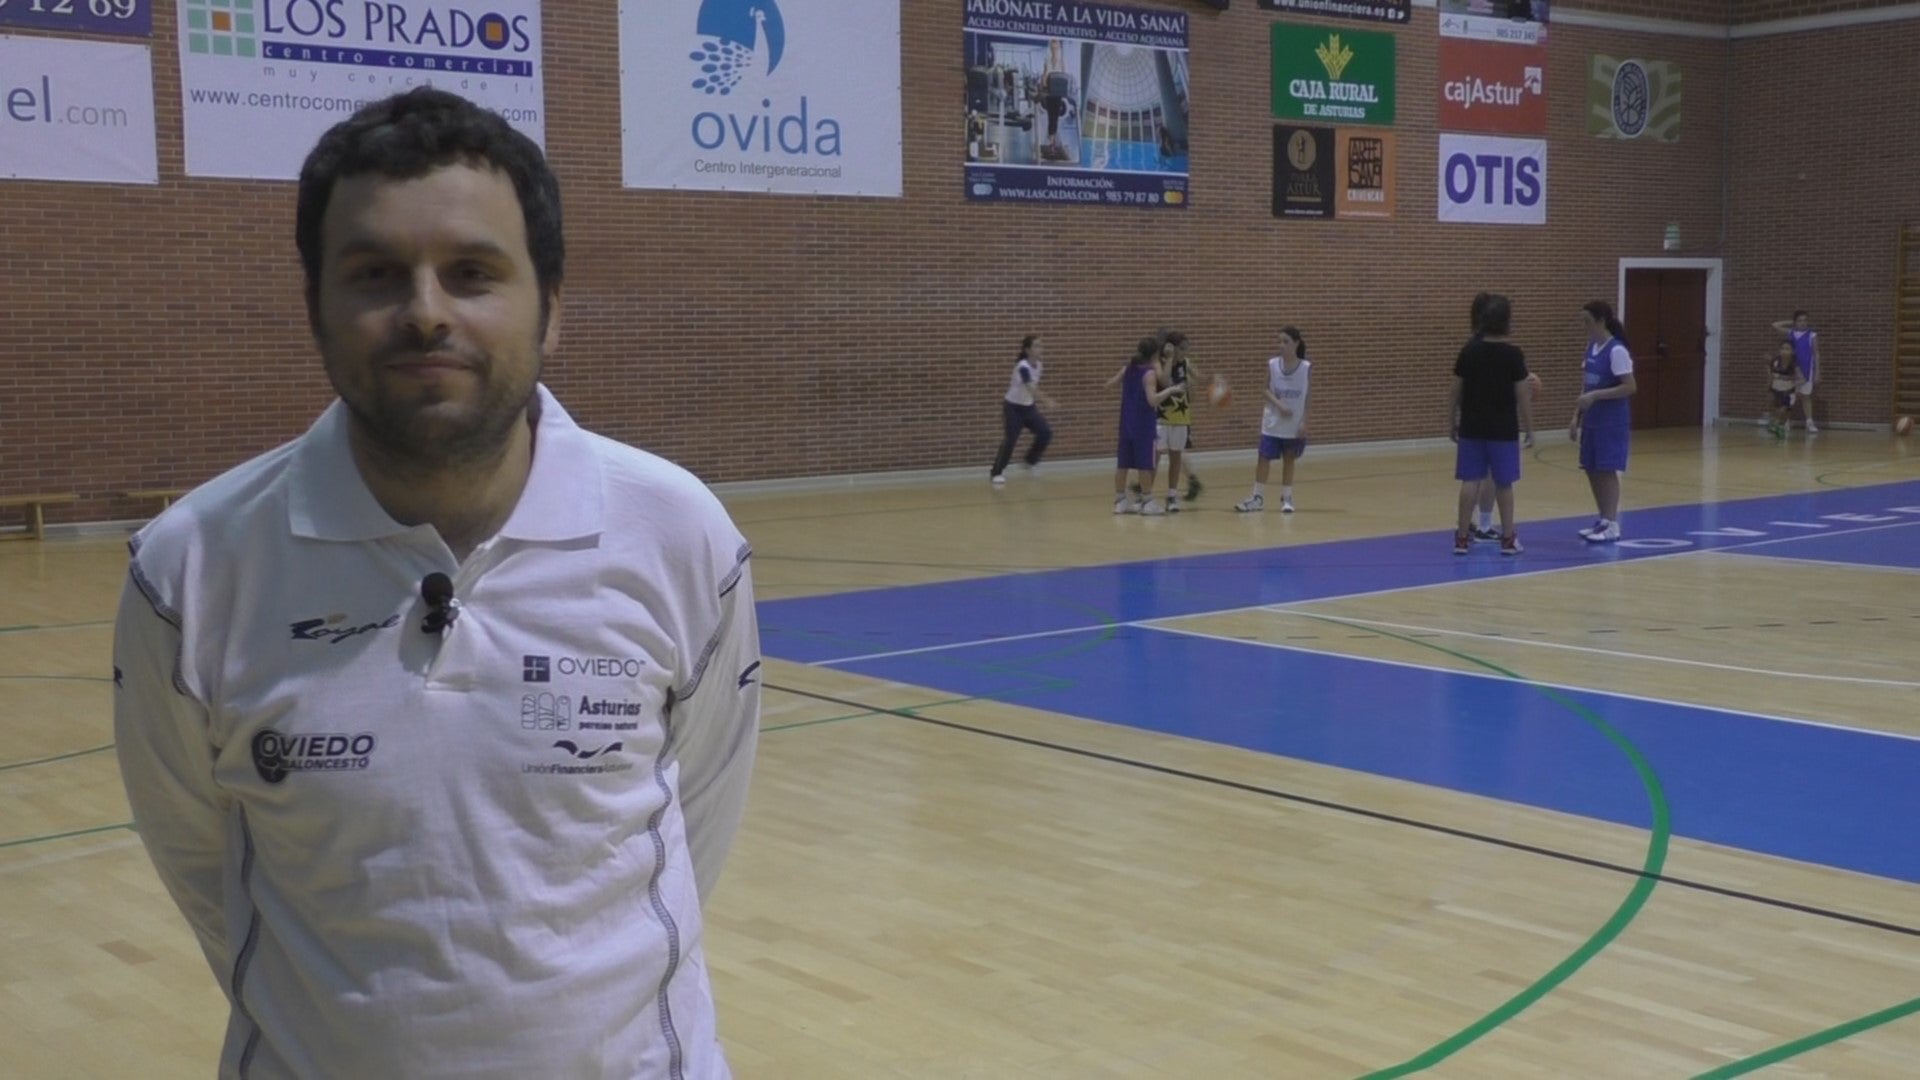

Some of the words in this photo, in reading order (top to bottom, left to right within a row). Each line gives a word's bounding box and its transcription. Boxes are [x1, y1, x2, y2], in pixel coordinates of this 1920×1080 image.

[264, 0, 346, 38] LOS
[365, 1, 530, 52] PRADOS
[967, 16, 1005, 29] ACCESO
[1007, 20, 1044, 33] CENTRO
[1046, 25, 1097, 38] DEPORTIVO
[1105, 30, 1139, 42] ACCESO
[1056, 6, 1068, 22] A
[1073, 7, 1092, 24] LA
[1096, 9, 1136, 29] VIDA
[1140, 14, 1185, 33] SANA!
[265, 46, 363, 63] centro
[389, 55, 527, 75] comercial
[264, 66, 318, 82] muy
[348, 72, 433, 87] cerca
[461, 79, 487, 91] de
[1289, 79, 1327, 100] CAJA
[1329, 82, 1378, 103] RURAL
[1444, 76, 1522, 109] cajAstur
[1304, 103, 1318, 115] DE
[1319, 105, 1365, 118] ASTURIAS
[692, 96, 842, 156] ovida
[694, 159, 736, 174] Centro
[740, 161, 842, 178] Intergeneracional
[1445, 153, 1541, 206] OTIS
[558, 657, 640, 677] OVIEDO
[578, 696, 641, 716] Asturias
[262, 735, 375, 757] OVIEDO
